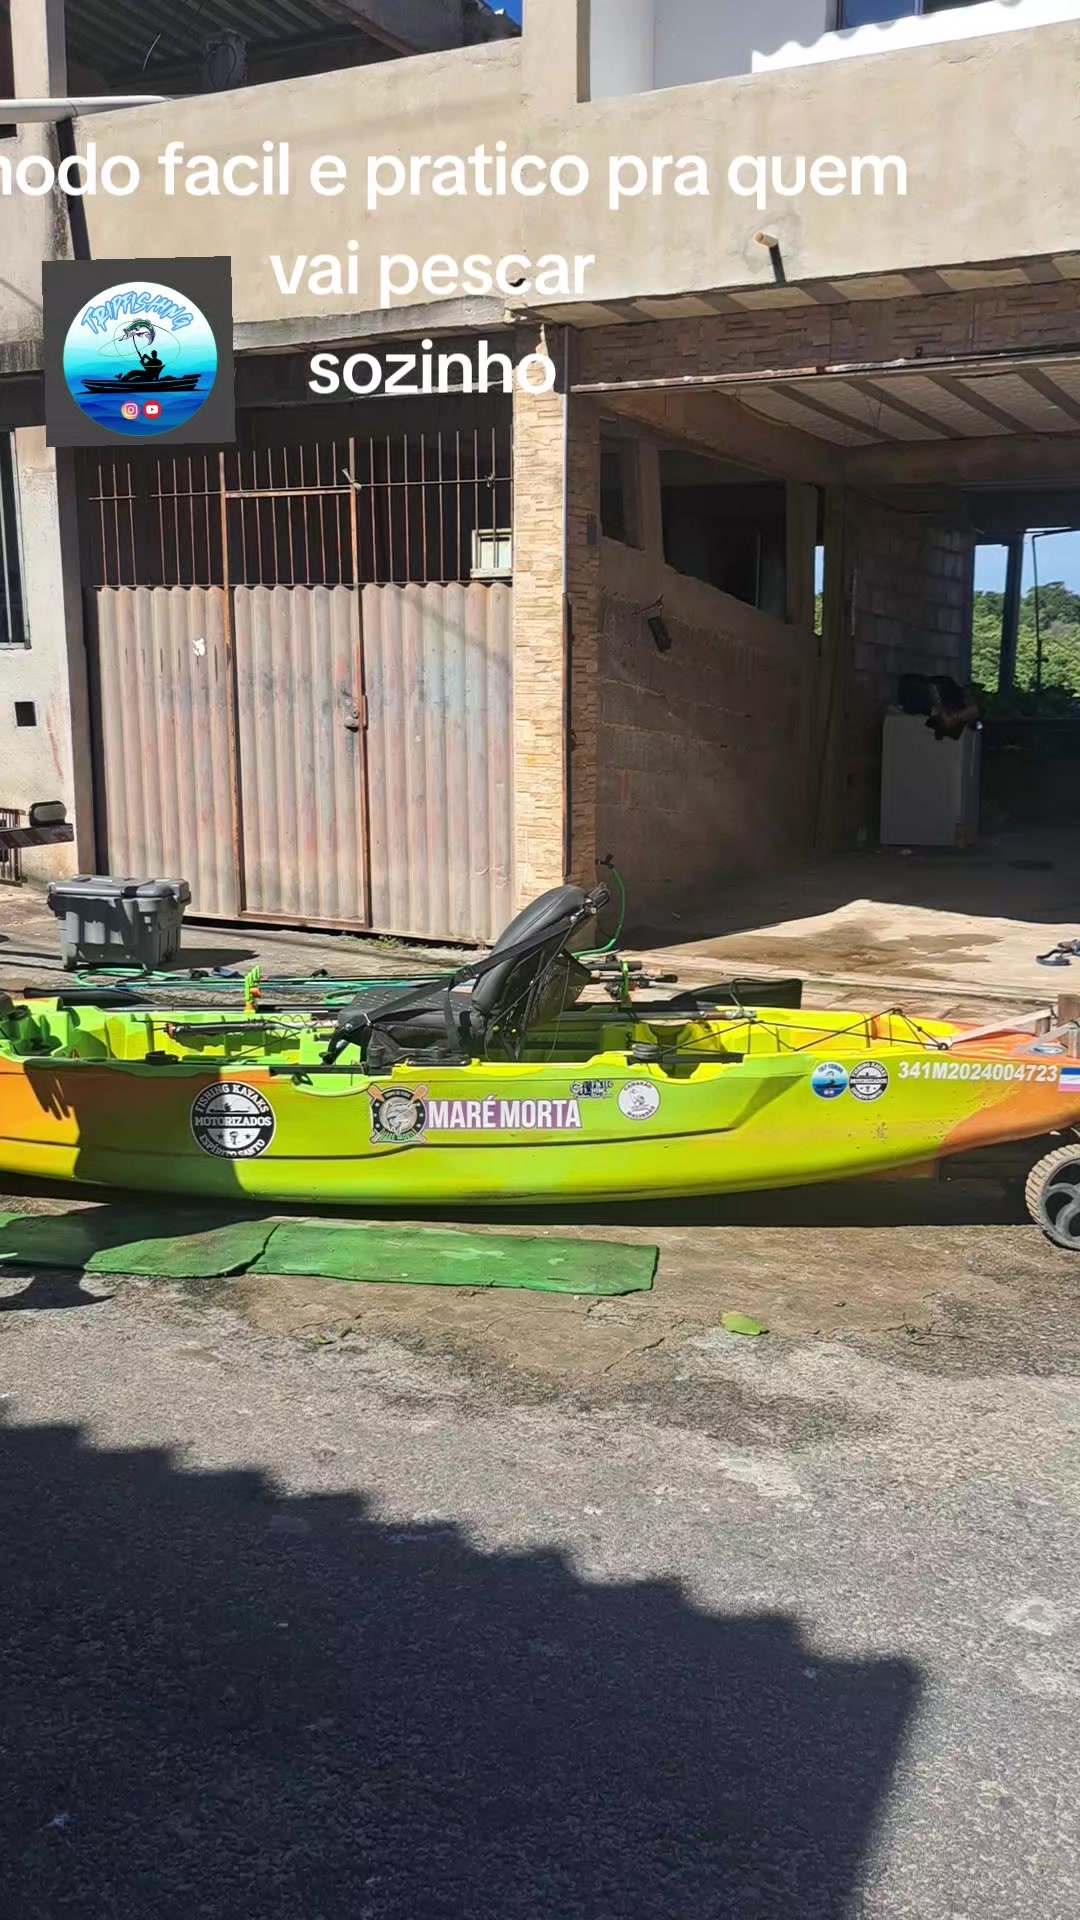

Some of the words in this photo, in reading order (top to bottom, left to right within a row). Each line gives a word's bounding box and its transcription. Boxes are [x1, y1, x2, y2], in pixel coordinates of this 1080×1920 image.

[897, 1061, 1059, 1082] 341M2024004723
[195, 1084, 230, 1113] FISHING
[232, 1084, 270, 1113] KAYAKS
[194, 1116, 272, 1127] MOTORIZADOS
[428, 1095, 497, 1129] MARÉ
[500, 1099, 582, 1129] MORTA
[238, 1138, 266, 1157] SANTO
